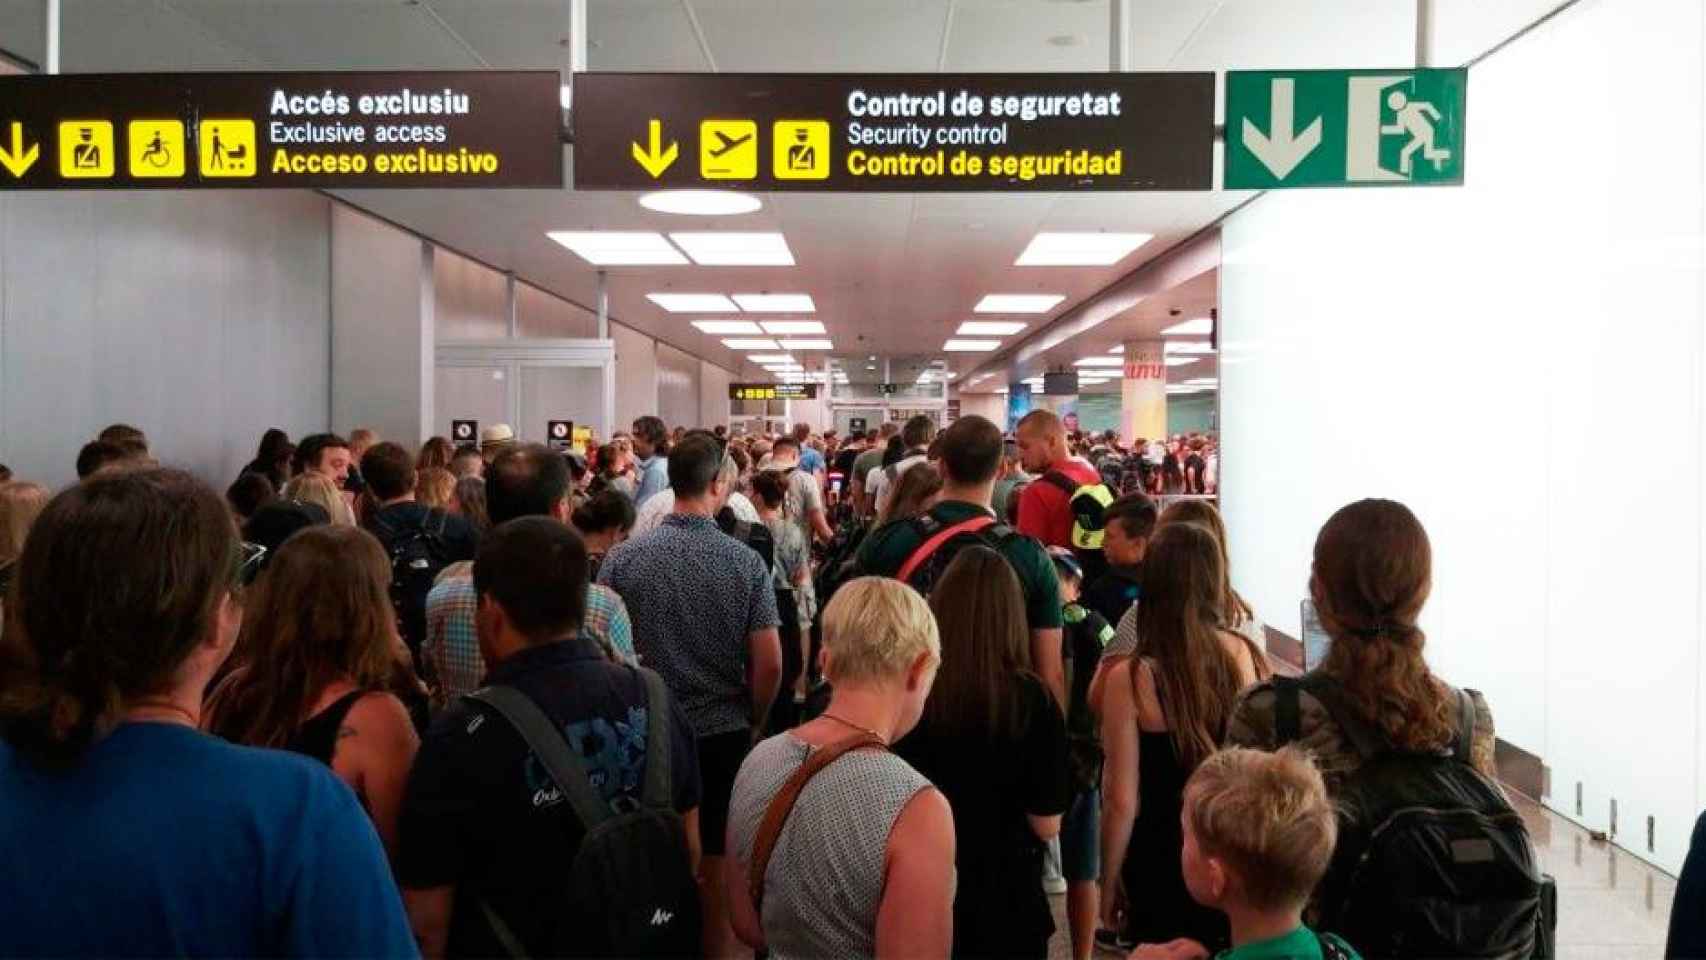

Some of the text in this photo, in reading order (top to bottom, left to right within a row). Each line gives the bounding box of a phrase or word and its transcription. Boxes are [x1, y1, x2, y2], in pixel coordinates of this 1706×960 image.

[270, 88, 470, 116] Accés exclusiu
[847, 90, 1121, 120] Control de seguretat
[270, 121, 447, 143] Exclusive access
[847, 121, 1007, 149] Security control
[271, 146, 499, 174] Acceso exclusivo
[846, 149, 1122, 180] Control de seguridad
